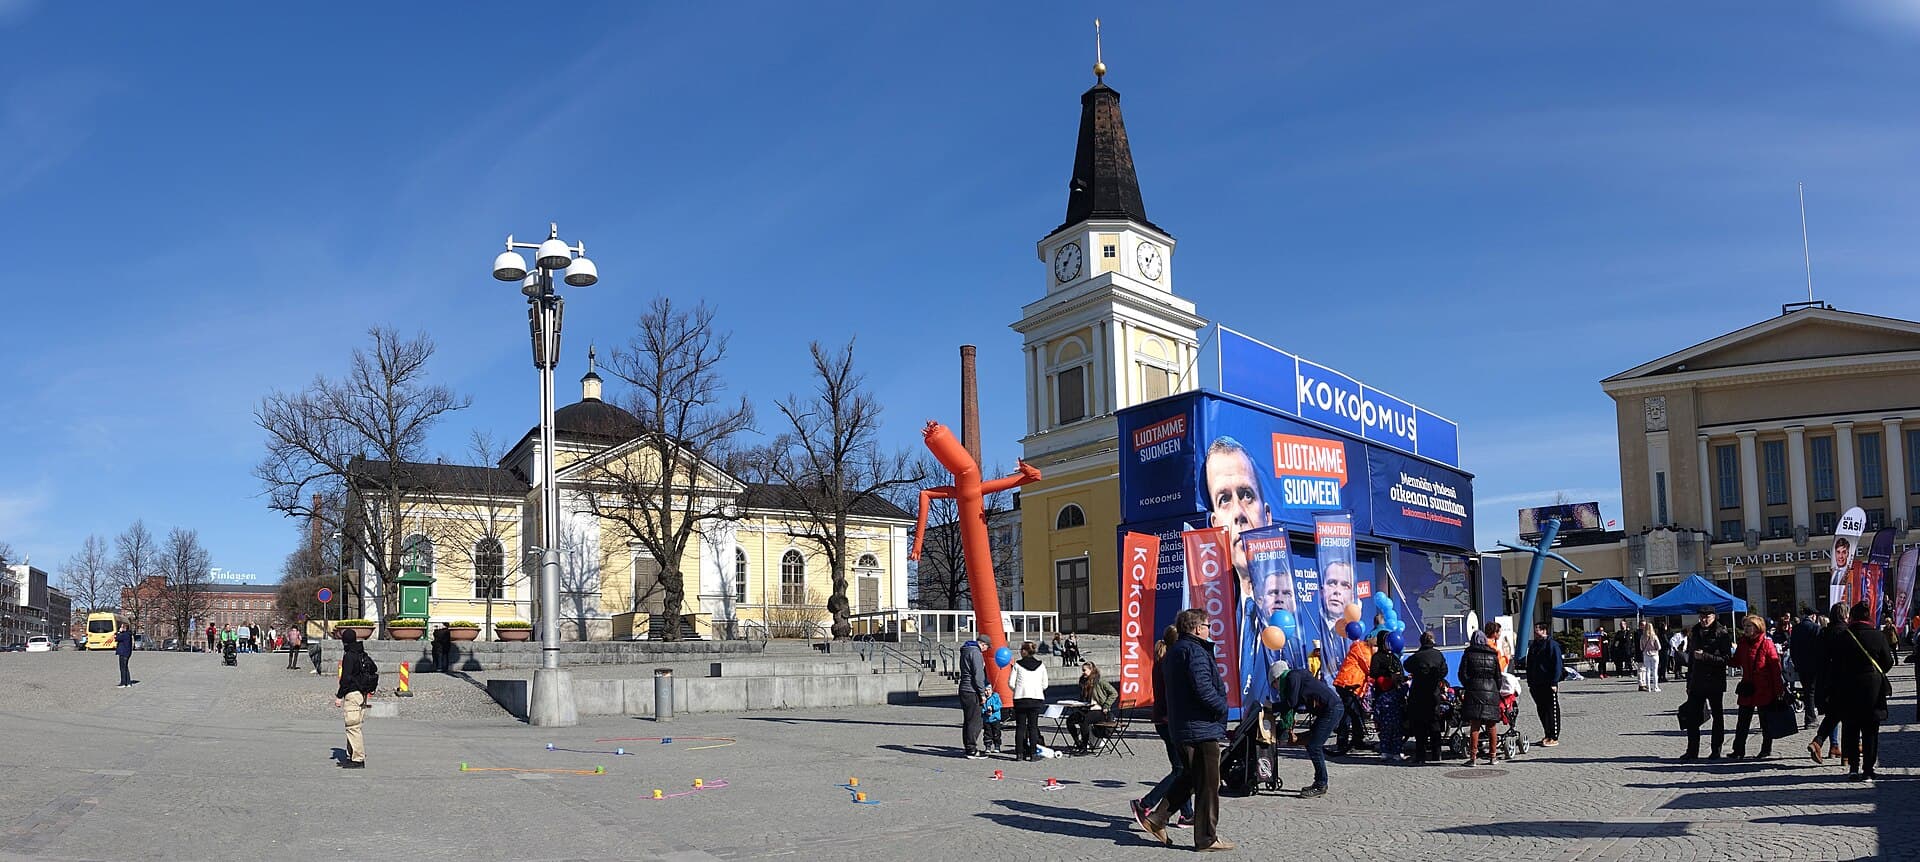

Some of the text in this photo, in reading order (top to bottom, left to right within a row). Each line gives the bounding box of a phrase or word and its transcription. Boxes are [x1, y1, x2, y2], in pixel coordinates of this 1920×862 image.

[1300, 375, 1416, 441] KOKOOMUS
[1135, 418, 1185, 447] LUOTAMME
[1140, 438, 1181, 462] SUOMEEN
[1276, 441, 1344, 474] LUOTAMME
[1139, 492, 1182, 506] KOKOOMUS
[1283, 478, 1340, 506] SUOMEEN
[1390, 483, 1429, 508] oikeaan
[1722, 549, 1832, 567] TAMPEREEN
[1122, 547, 1147, 694] KOKOOMUS
